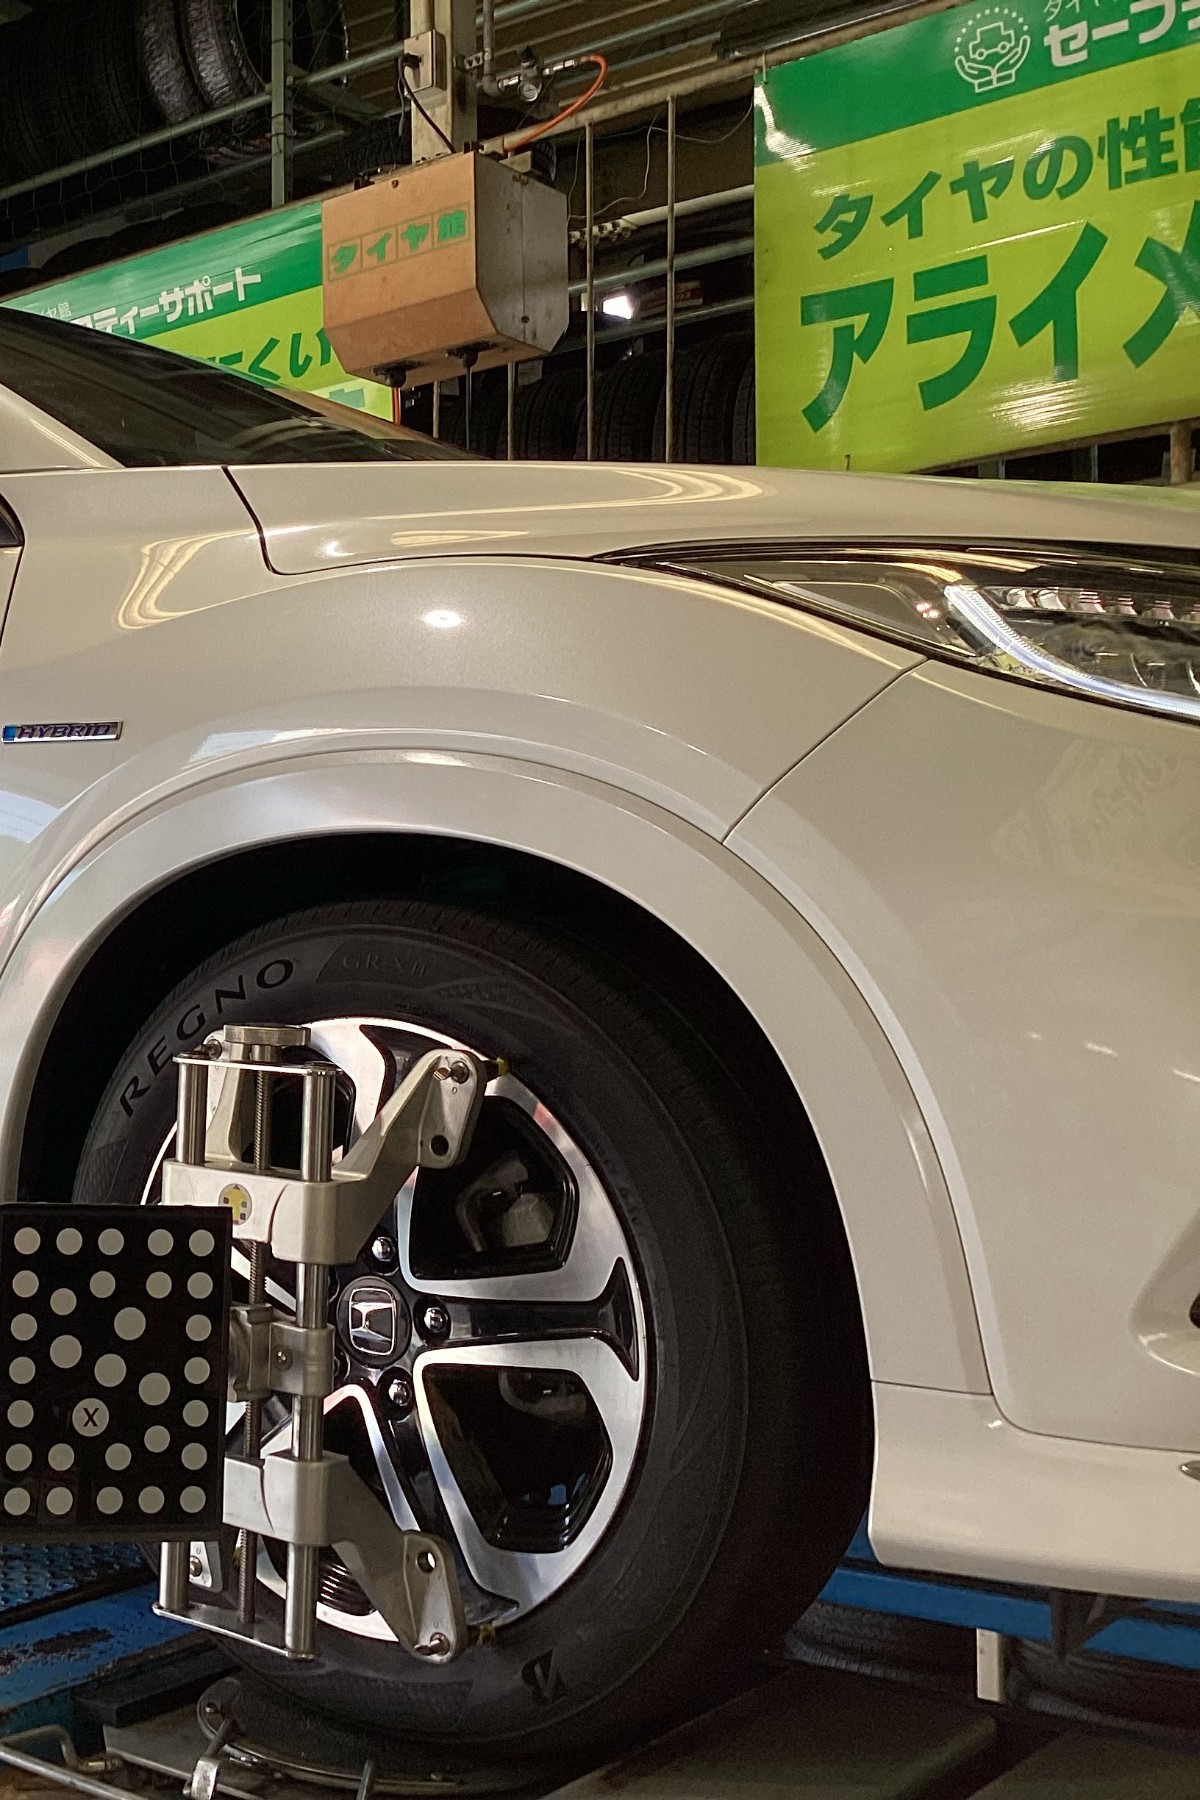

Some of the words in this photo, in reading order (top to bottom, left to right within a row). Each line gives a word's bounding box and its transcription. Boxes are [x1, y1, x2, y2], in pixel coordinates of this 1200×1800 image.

[331, 209, 467, 274] タイヤ館
[17, 723, 112, 740] HYBRID
[119, 958, 294, 1117] REGNO
[82, 1407, 100, 1427] X
